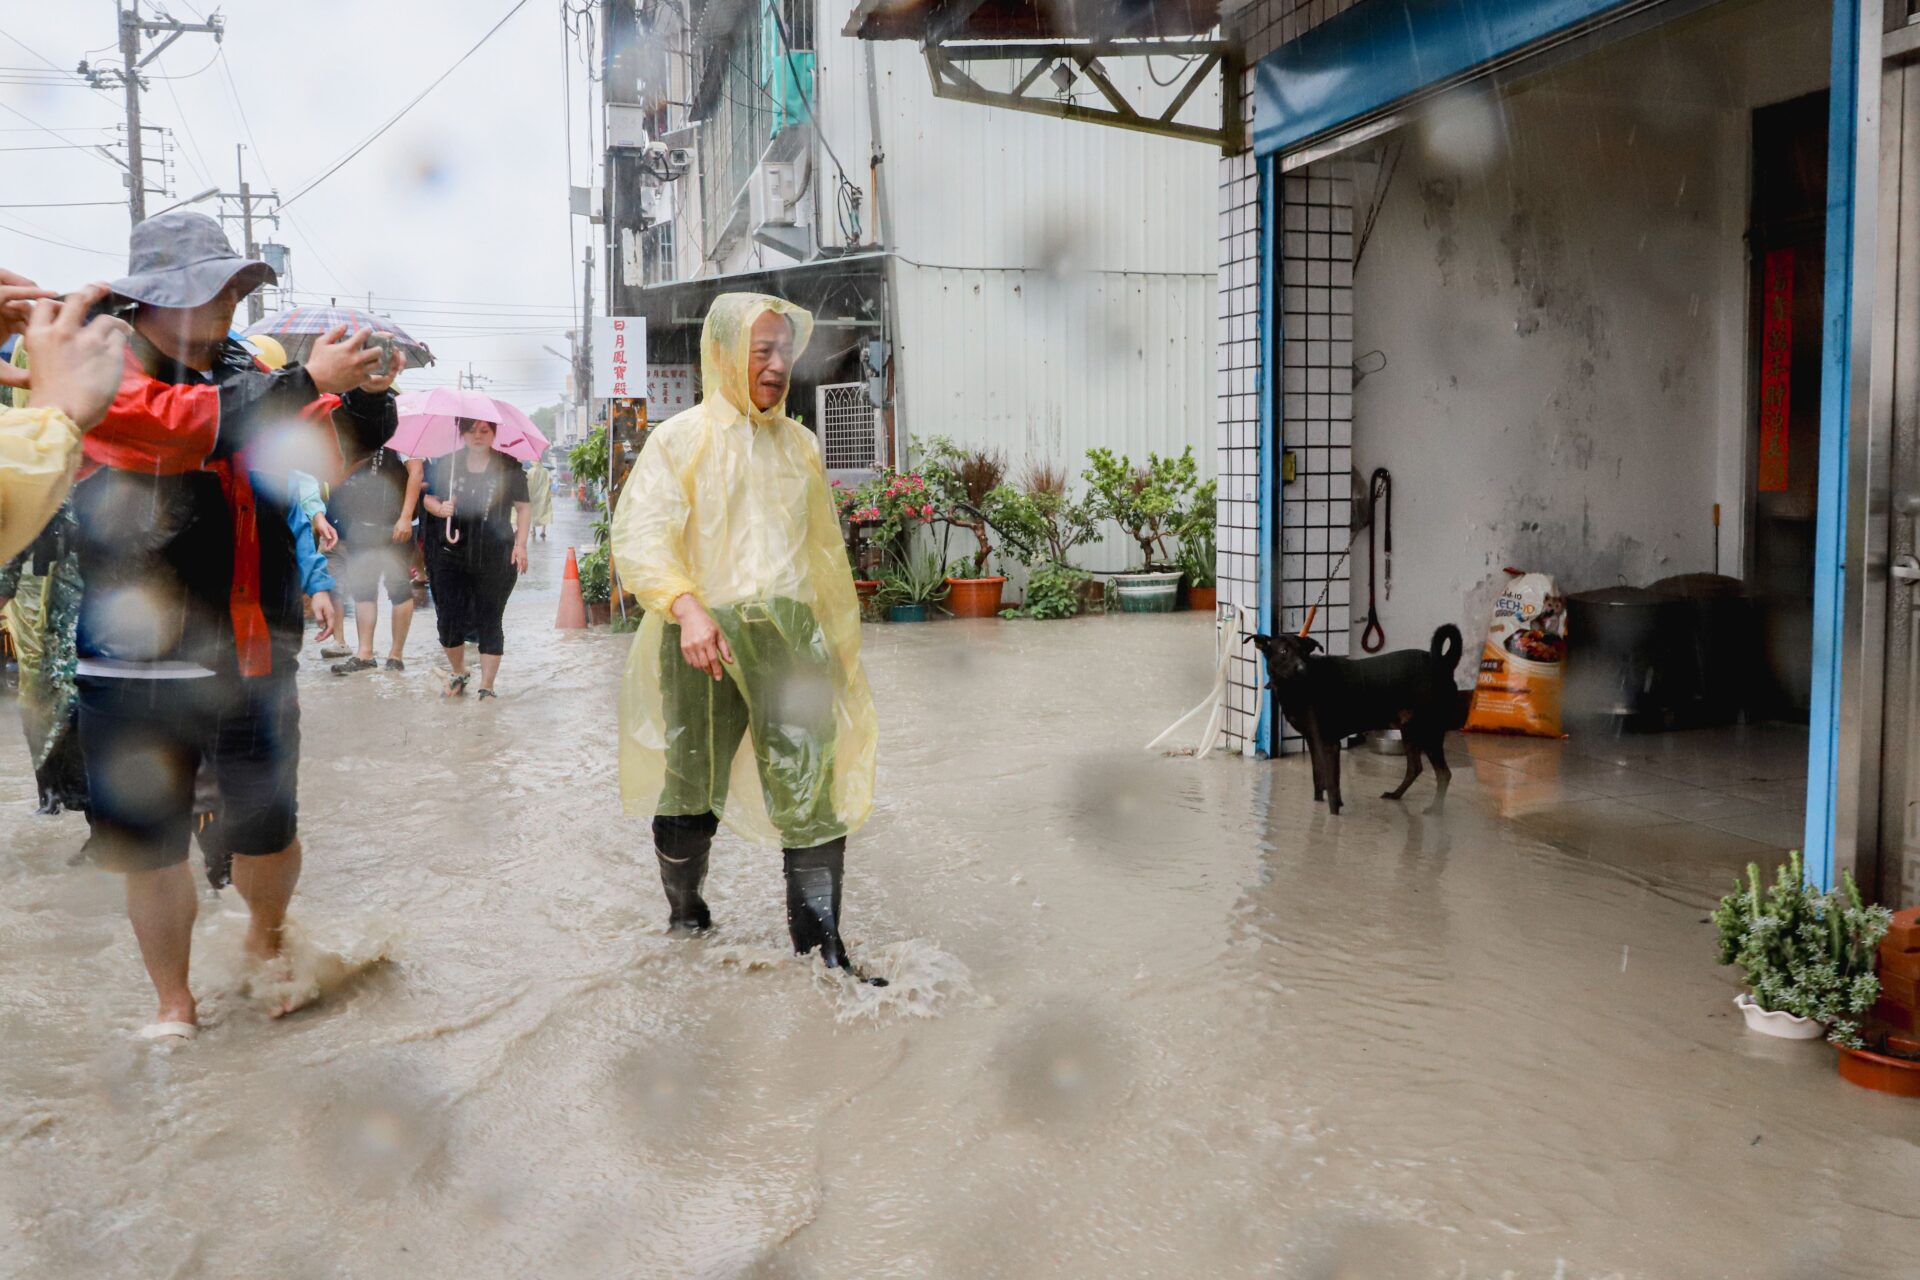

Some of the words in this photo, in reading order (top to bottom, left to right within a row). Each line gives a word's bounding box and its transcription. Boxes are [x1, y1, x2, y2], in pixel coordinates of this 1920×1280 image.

[613, 319, 627, 395] 日月鳳寶殿
